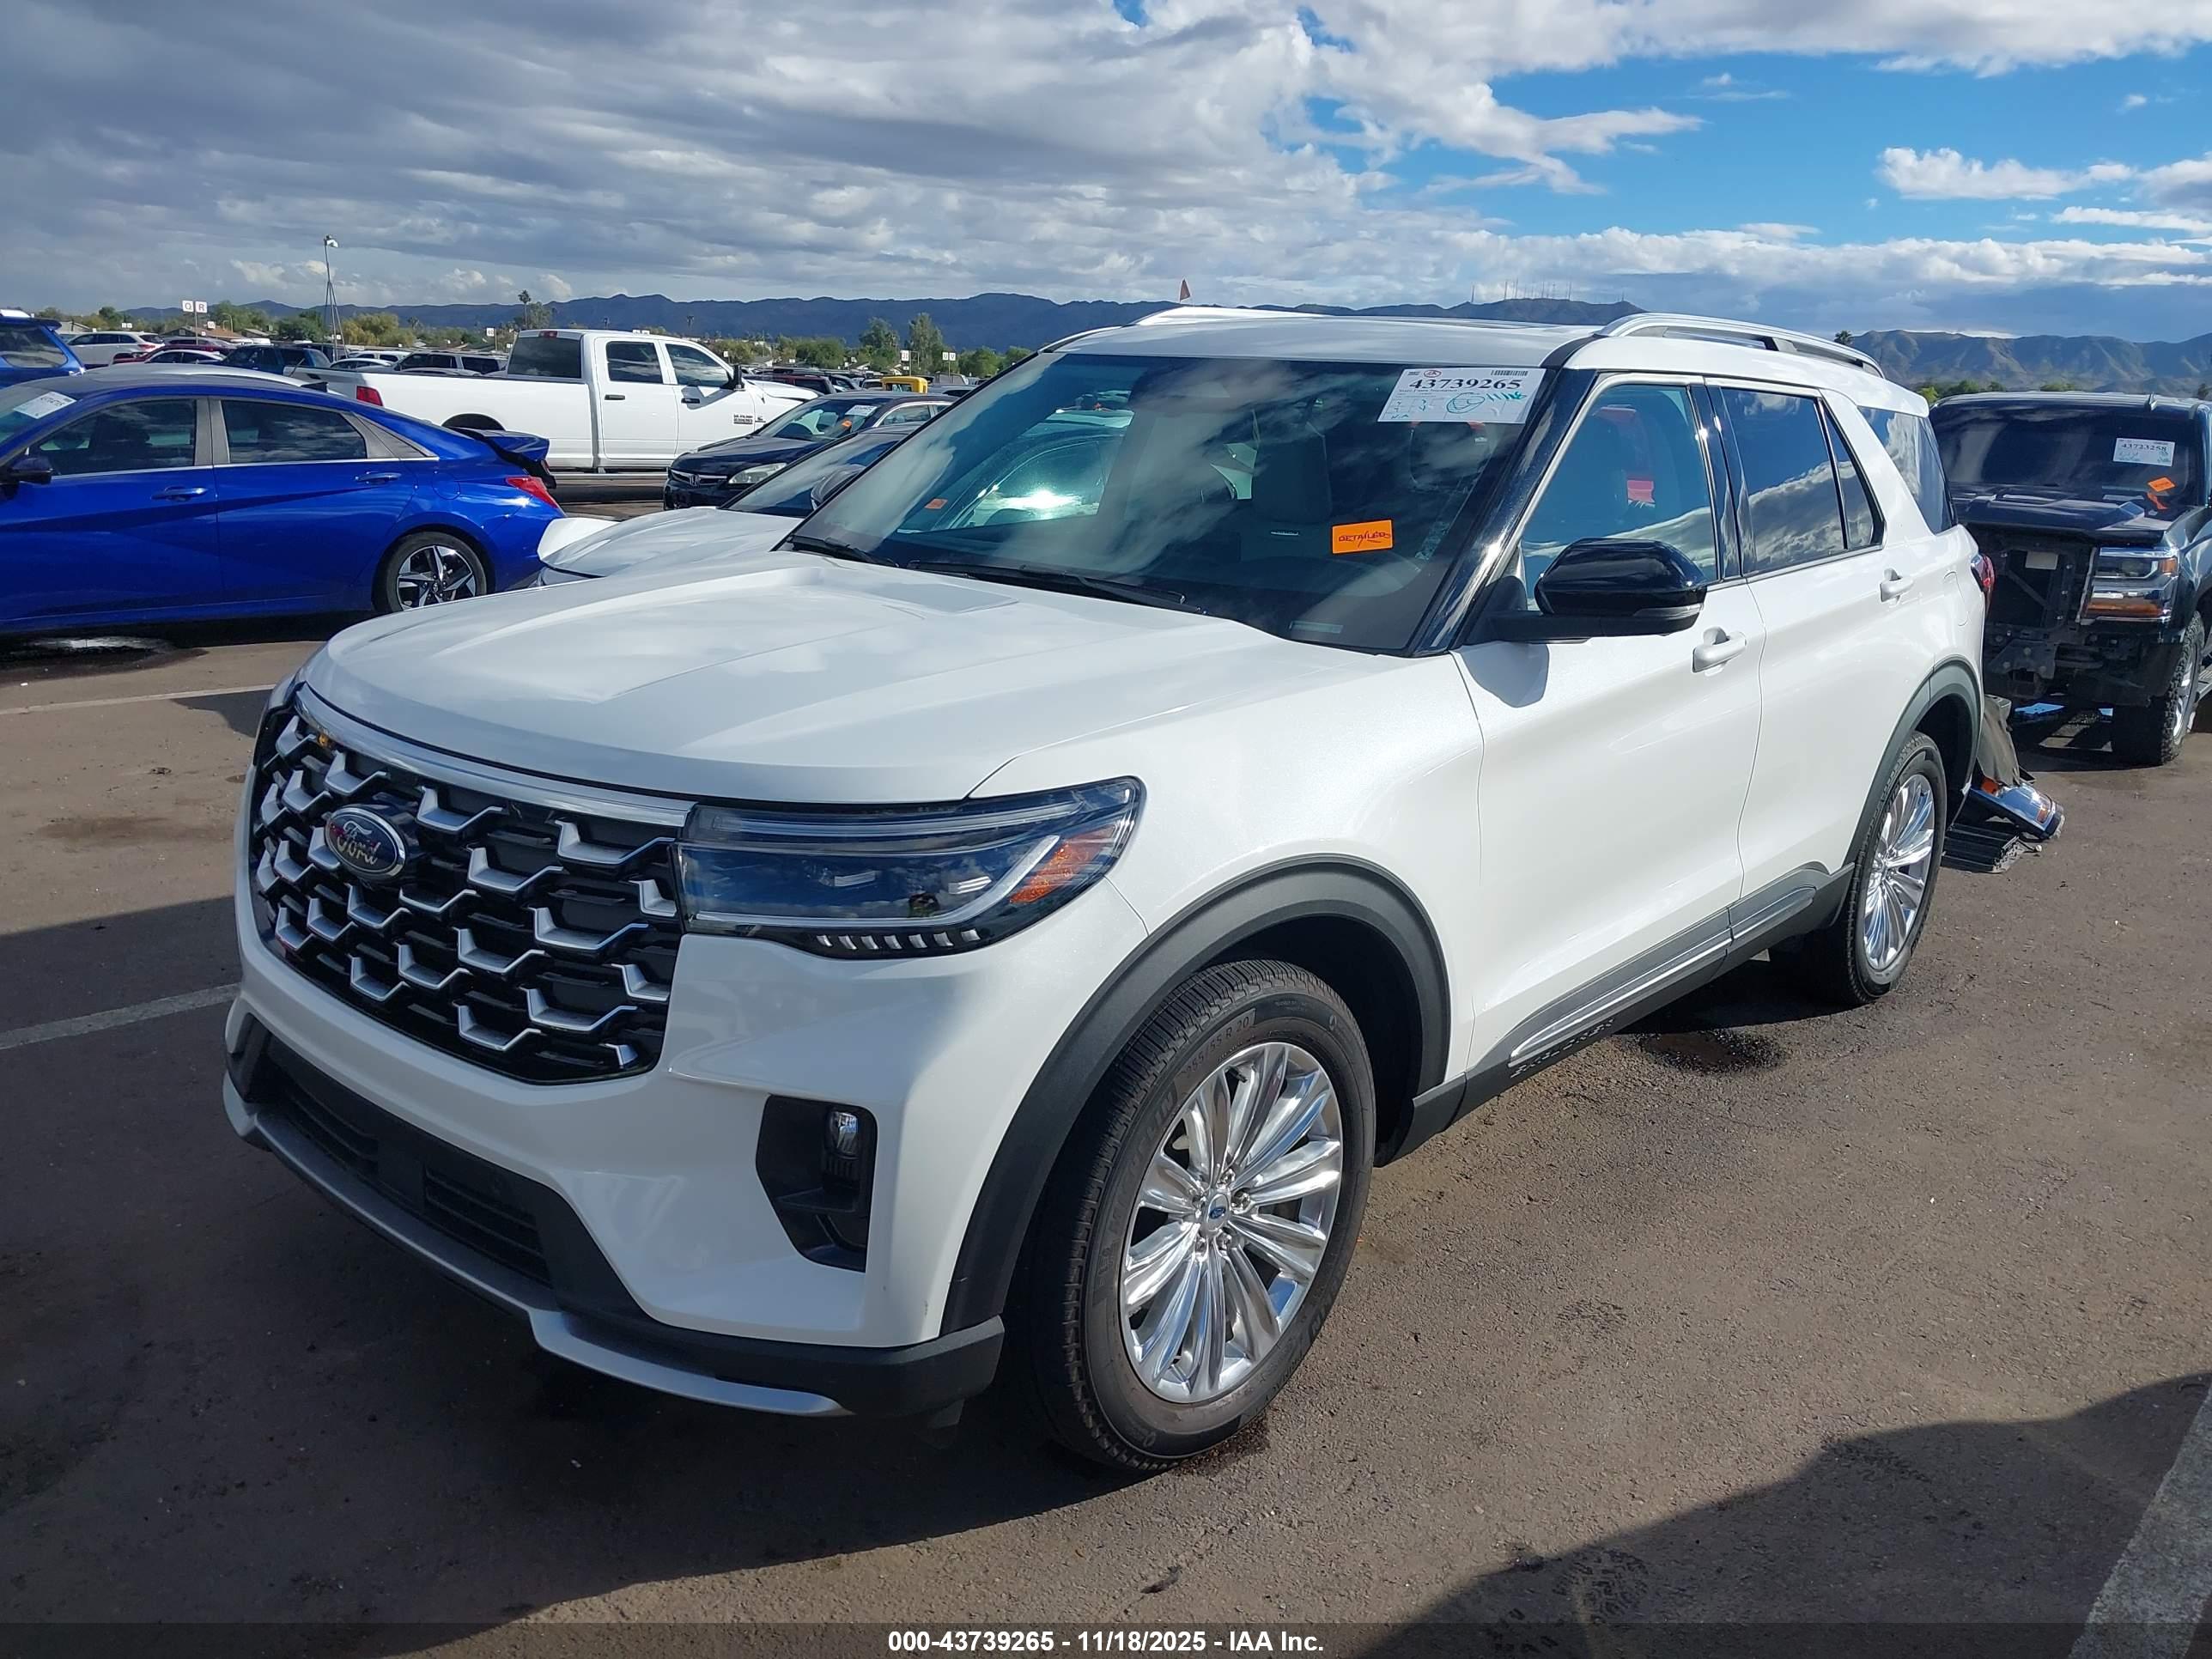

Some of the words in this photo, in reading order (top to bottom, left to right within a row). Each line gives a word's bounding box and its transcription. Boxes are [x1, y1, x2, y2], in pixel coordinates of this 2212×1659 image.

[1408, 379, 1523, 389] 43739265
[337, 820, 381, 866] Ford
[1225, 1026, 1233, 1038] R
[1236, 1016, 1250, 1033] 20
